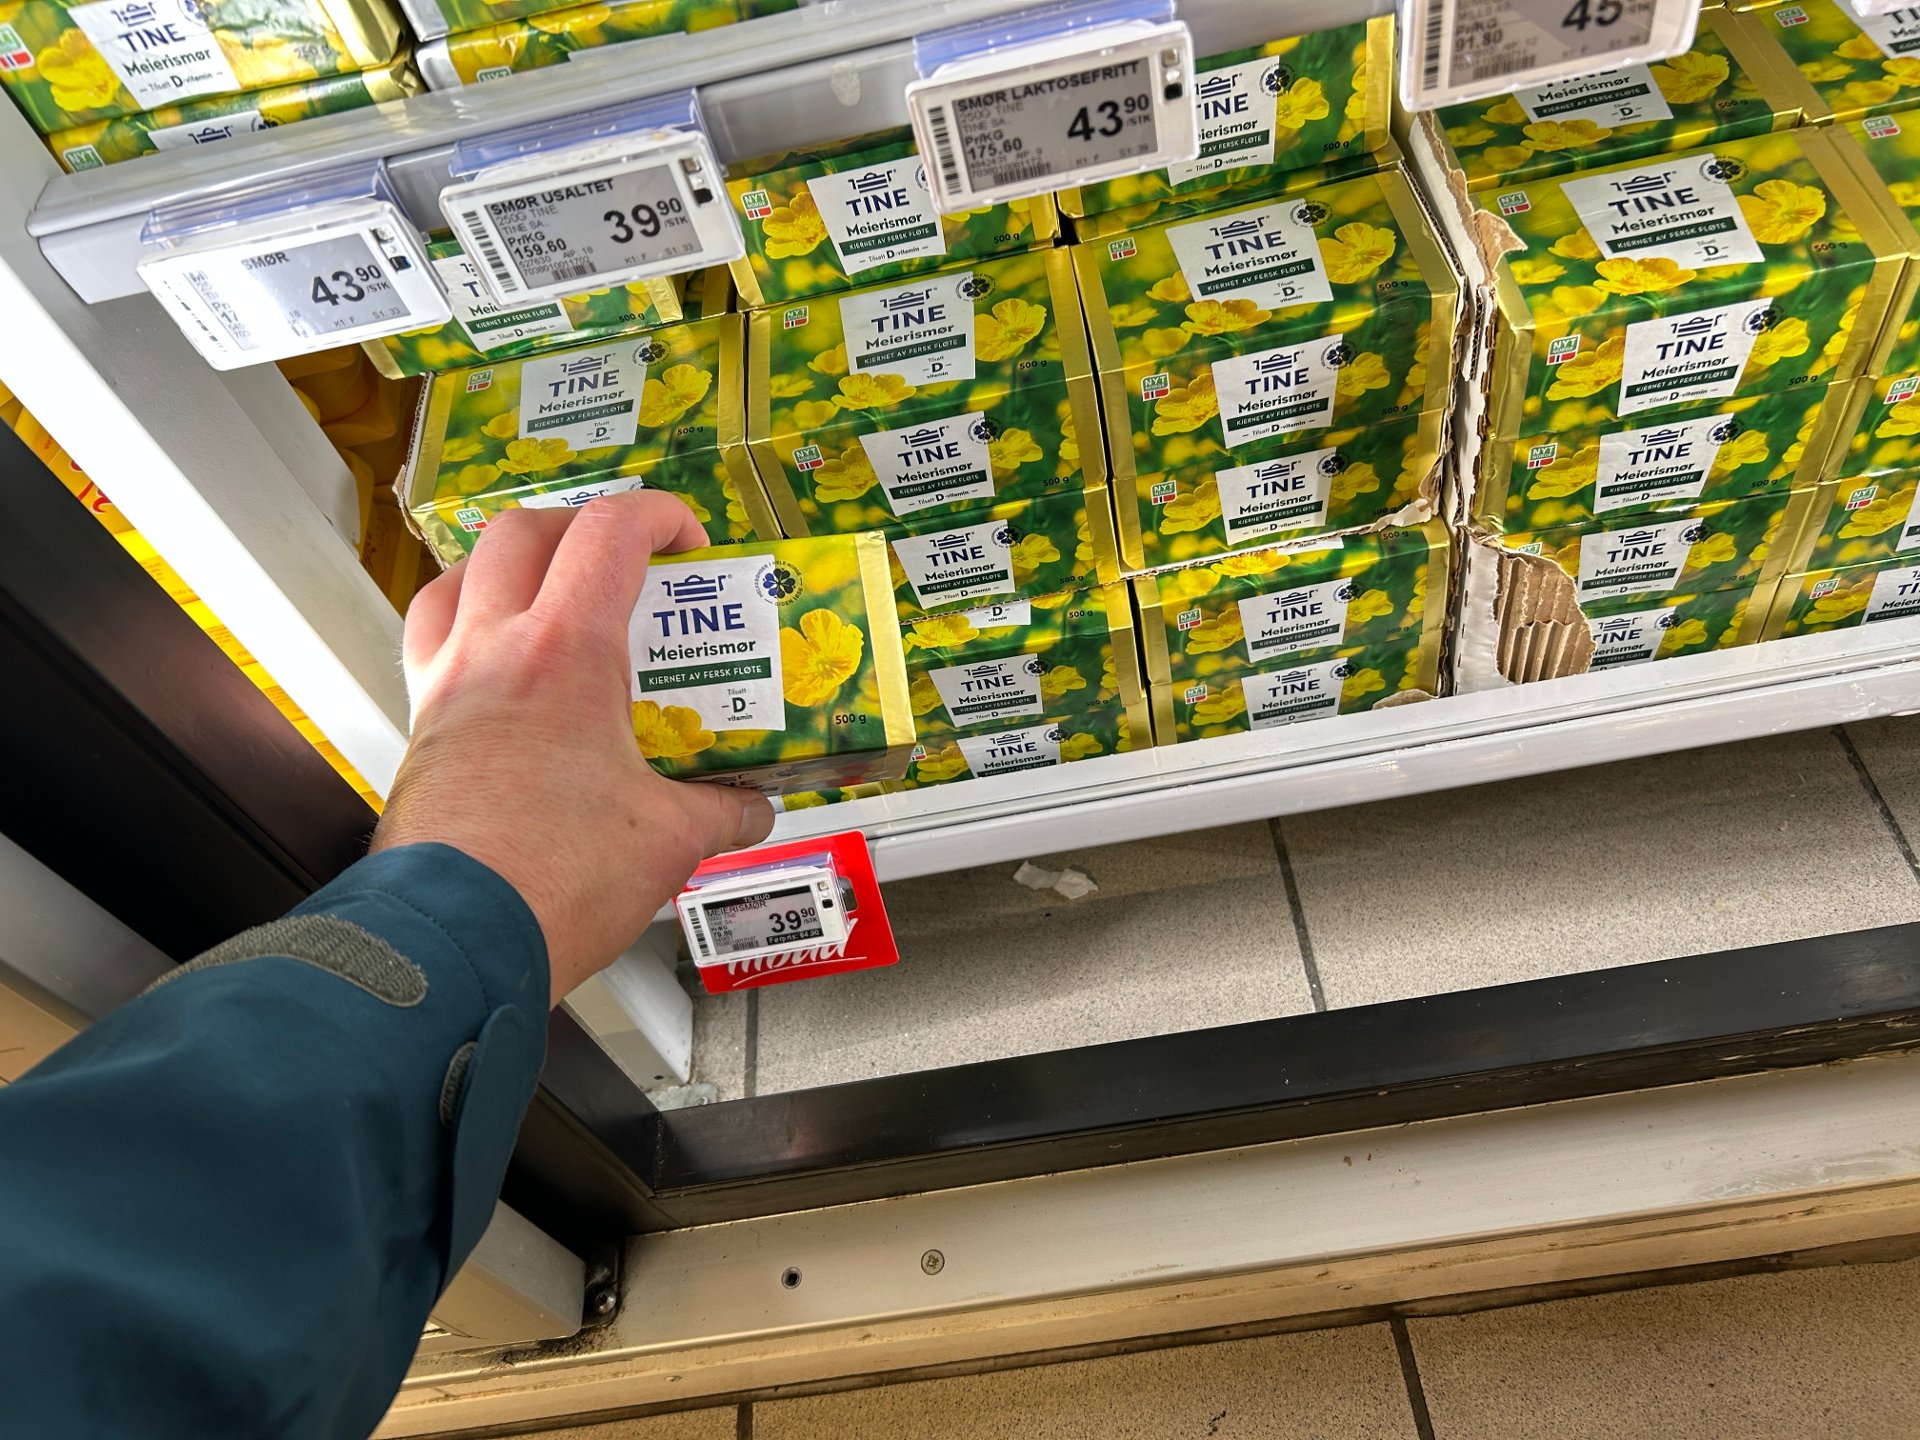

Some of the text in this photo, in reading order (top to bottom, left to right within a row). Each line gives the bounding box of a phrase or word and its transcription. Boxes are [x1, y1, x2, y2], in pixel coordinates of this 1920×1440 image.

[118, 23, 186, 52] TINE
[122, 50, 211, 77] Meierismør
[957, 61, 1139, 112] SMØR LAKTOSEFRITT
[1537, 77, 1630, 102] Meierismør
[1196, 93, 1248, 120] INE
[1067, 94, 1149, 142] 43 90
[967, 137, 1023, 160] 175.60
[1219, 140, 1239, 149] FERSK
[1241, 135, 1261, 144] FLØTE
[1323, 140, 1350, 152] 500 g
[68, 151, 95, 163] NYT
[491, 178, 615, 216] SMØR USALTET
[743, 191, 766, 204] NYT
[846, 188, 910, 217] TINE
[1608, 187, 1700, 217] TINE
[499, 205, 558, 227] 250G TINE
[603, 198, 682, 244] 39 90
[664, 216, 688, 228] /STK
[846, 213, 922, 238] Meierismør
[1611, 207, 1715, 234] Meierismør
[507, 231, 545, 247] Pr/KG
[849, 228, 930, 250] KJERNET AV FERSK FLØTE
[993, 232, 1020, 244] 500 g
[1618, 237, 1652, 248] KJERNET
[1669, 229, 1696, 238] FERSK
[1698, 222, 1727, 233] FLØTE
[514, 238, 568, 261] 159.60
[1205, 231, 1287, 261] TINE
[1813, 241, 1848, 253] 500 g
[241, 252, 289, 270] SMØR
[1204, 249, 1298, 277] Meierismør
[311, 265, 381, 306] 43 90
[366, 282, 390, 293] /STK
[1207, 280, 1241, 292] KJERNET
[1253, 271, 1279, 282] FERSK
[1279, 264, 1306, 275] FLØTE
[1379, 279, 1409, 291] 500 g
[619, 312, 645, 323] 500 g
[871, 304, 946, 333] TINE
[865, 325, 954, 350] Meierismør
[1656, 332, 1727, 360] TINE
[1019, 359, 1047, 371] 500 g
[1642, 356, 1729, 380] Meierismør
[549, 370, 619, 397] TINE
[1143, 376, 1166, 388] NYT
[1245, 368, 1309, 395] TINE
[1636, 382, 1666, 392] KJERNET
[1680, 375, 1703, 383] FERSK
[1704, 370, 1728, 379] FLØTE
[1788, 374, 1818, 386] 500 g
[539, 390, 625, 414] Meierismør
[1238, 389, 1317, 414] Meierismør
[1382, 403, 1408, 415] 500 g
[534, 405, 625, 428] KJERNET AV FERSK FLØTE
[677, 427, 695, 436] 500
[897, 441, 962, 468] TINE
[1629, 443, 1693, 465] TINE
[896, 461, 972, 484] Meierismør
[1042, 475, 1069, 487] 500 g
[1615, 462, 1695, 483] Meierismør
[1247, 475, 1305, 499] TINE
[1240, 492, 1312, 515] Meierismør
[1382, 529, 1409, 540] 500 g
[927, 545, 985, 567] TINE
[1607, 543, 1664, 563] TINE
[925, 563, 996, 582] Meierismør
[1059, 574, 1084, 584] 500 g
[1595, 560, 1670, 577] Meierismør
[652, 603, 745, 637] TINE
[1069, 610, 1093, 619] 500 g
[1267, 602, 1323, 623] TINE
[1261, 617, 1330, 637] Meierismør
[648, 640, 756, 663] Meierismør
[649, 665, 762, 686] KJERNET AV FERSK FLØTE
[961, 674, 1016, 692] TINE
[728, 688, 747, 696] Tilsatt
[958, 688, 1025, 705] Meierismør
[1268, 679, 1320, 697] TINE
[732, 697, 746, 713] D
[1262, 692, 1326, 709] Meierismør
[727, 714, 753, 722] vitamin
[835, 714, 866, 725] 500 g
[984, 753, 1046, 769] Meierismør
[986, 742, 1037, 759] TINE
[744, 893, 770, 902] TILBUD
[707, 901, 767, 916] MEIERISMØR
[769, 907, 815, 933] 39 90
